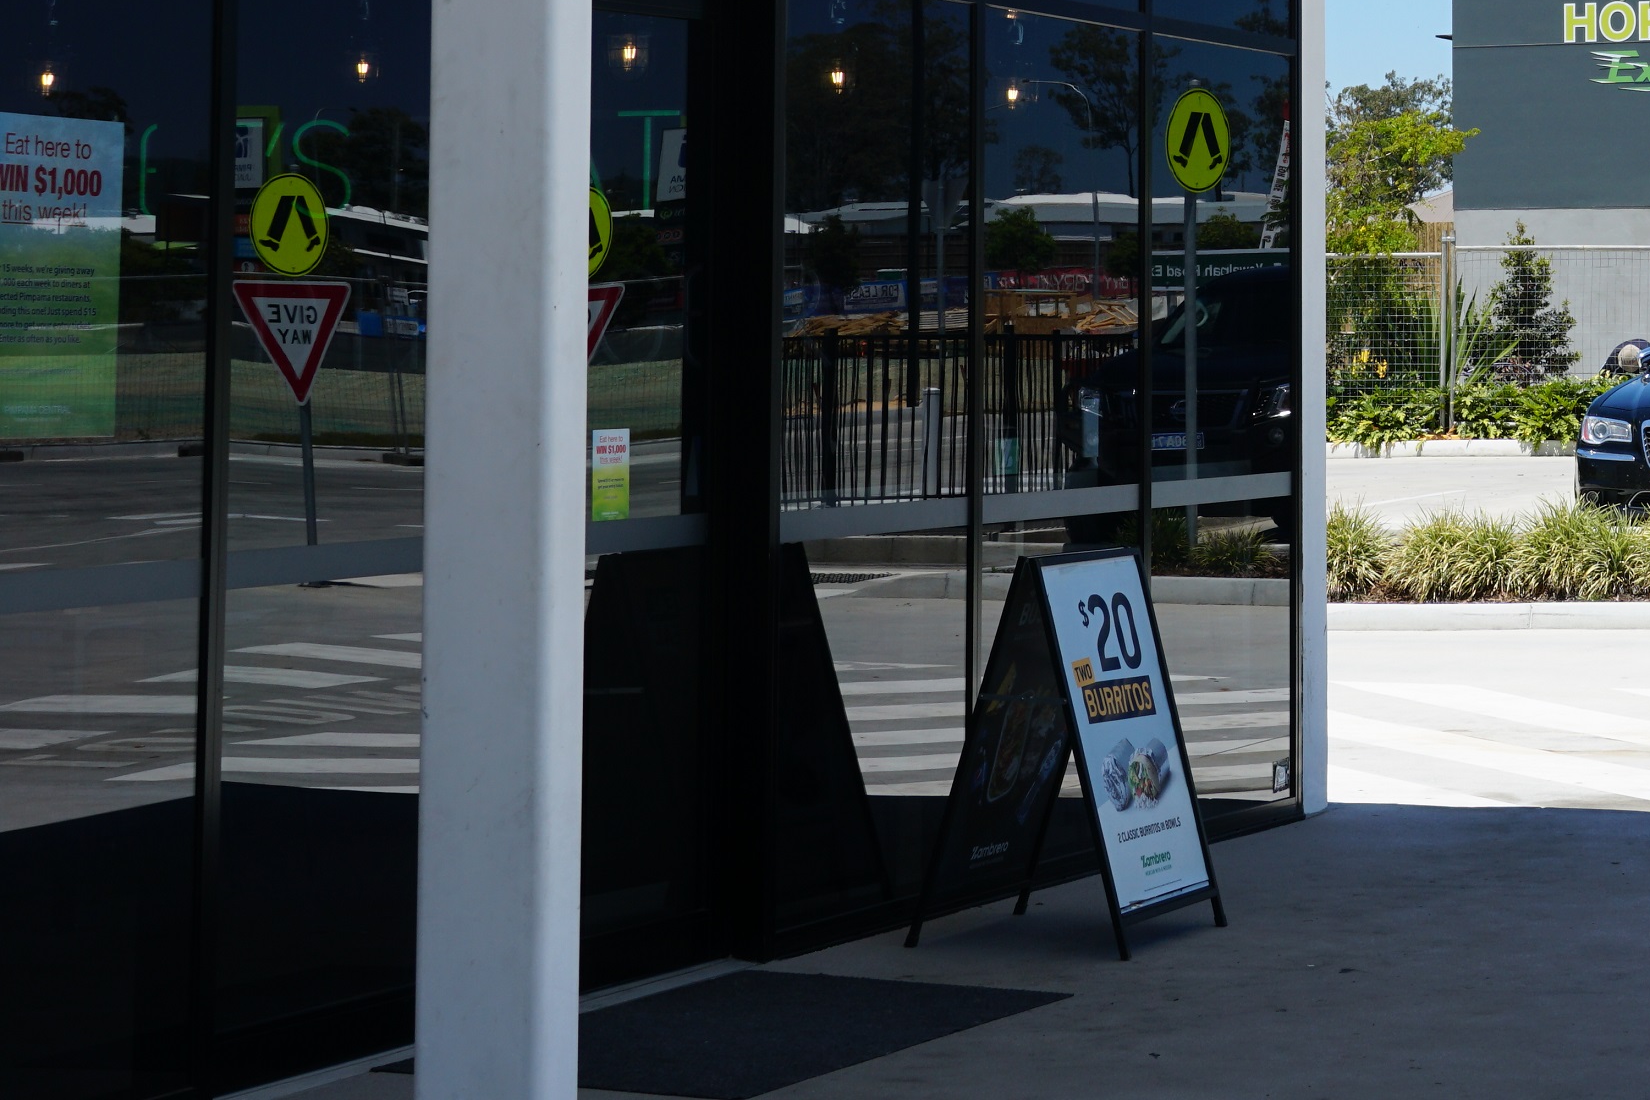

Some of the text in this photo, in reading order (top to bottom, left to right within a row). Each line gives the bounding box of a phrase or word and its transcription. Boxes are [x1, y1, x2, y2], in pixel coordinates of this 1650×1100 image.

[5, 132, 92, 159] Eat here to
[34, 164, 102, 200] $1,000
[2, 199, 87, 224] this week!
[54, 266, 75, 276] giving
[76, 267, 95, 277] away
[16, 279, 33, 287] each
[34, 279, 51, 288] week
[61, 280, 82, 289] diners
[83, 281, 91, 289] at
[20, 293, 51, 303] Pimpama
[17, 306, 30, 315] this
[62, 308, 82, 317] spend
[26, 334, 44, 343] often
[54, 336, 67, 345] you
[1078, 592, 1142, 672] $20
[1074, 663, 1093, 683] TWO
[1084, 681, 1152, 718] BURRITOS
[1117, 833, 1123, 843] 2
[1121, 828, 1141, 843] CLASSIC
[1139, 822, 1161, 837] BURRITOS
[1165, 816, 1181, 830] BOWLS
[970, 841, 1009, 861] Zambrero
[1140, 851, 1171, 868] Zambrero
